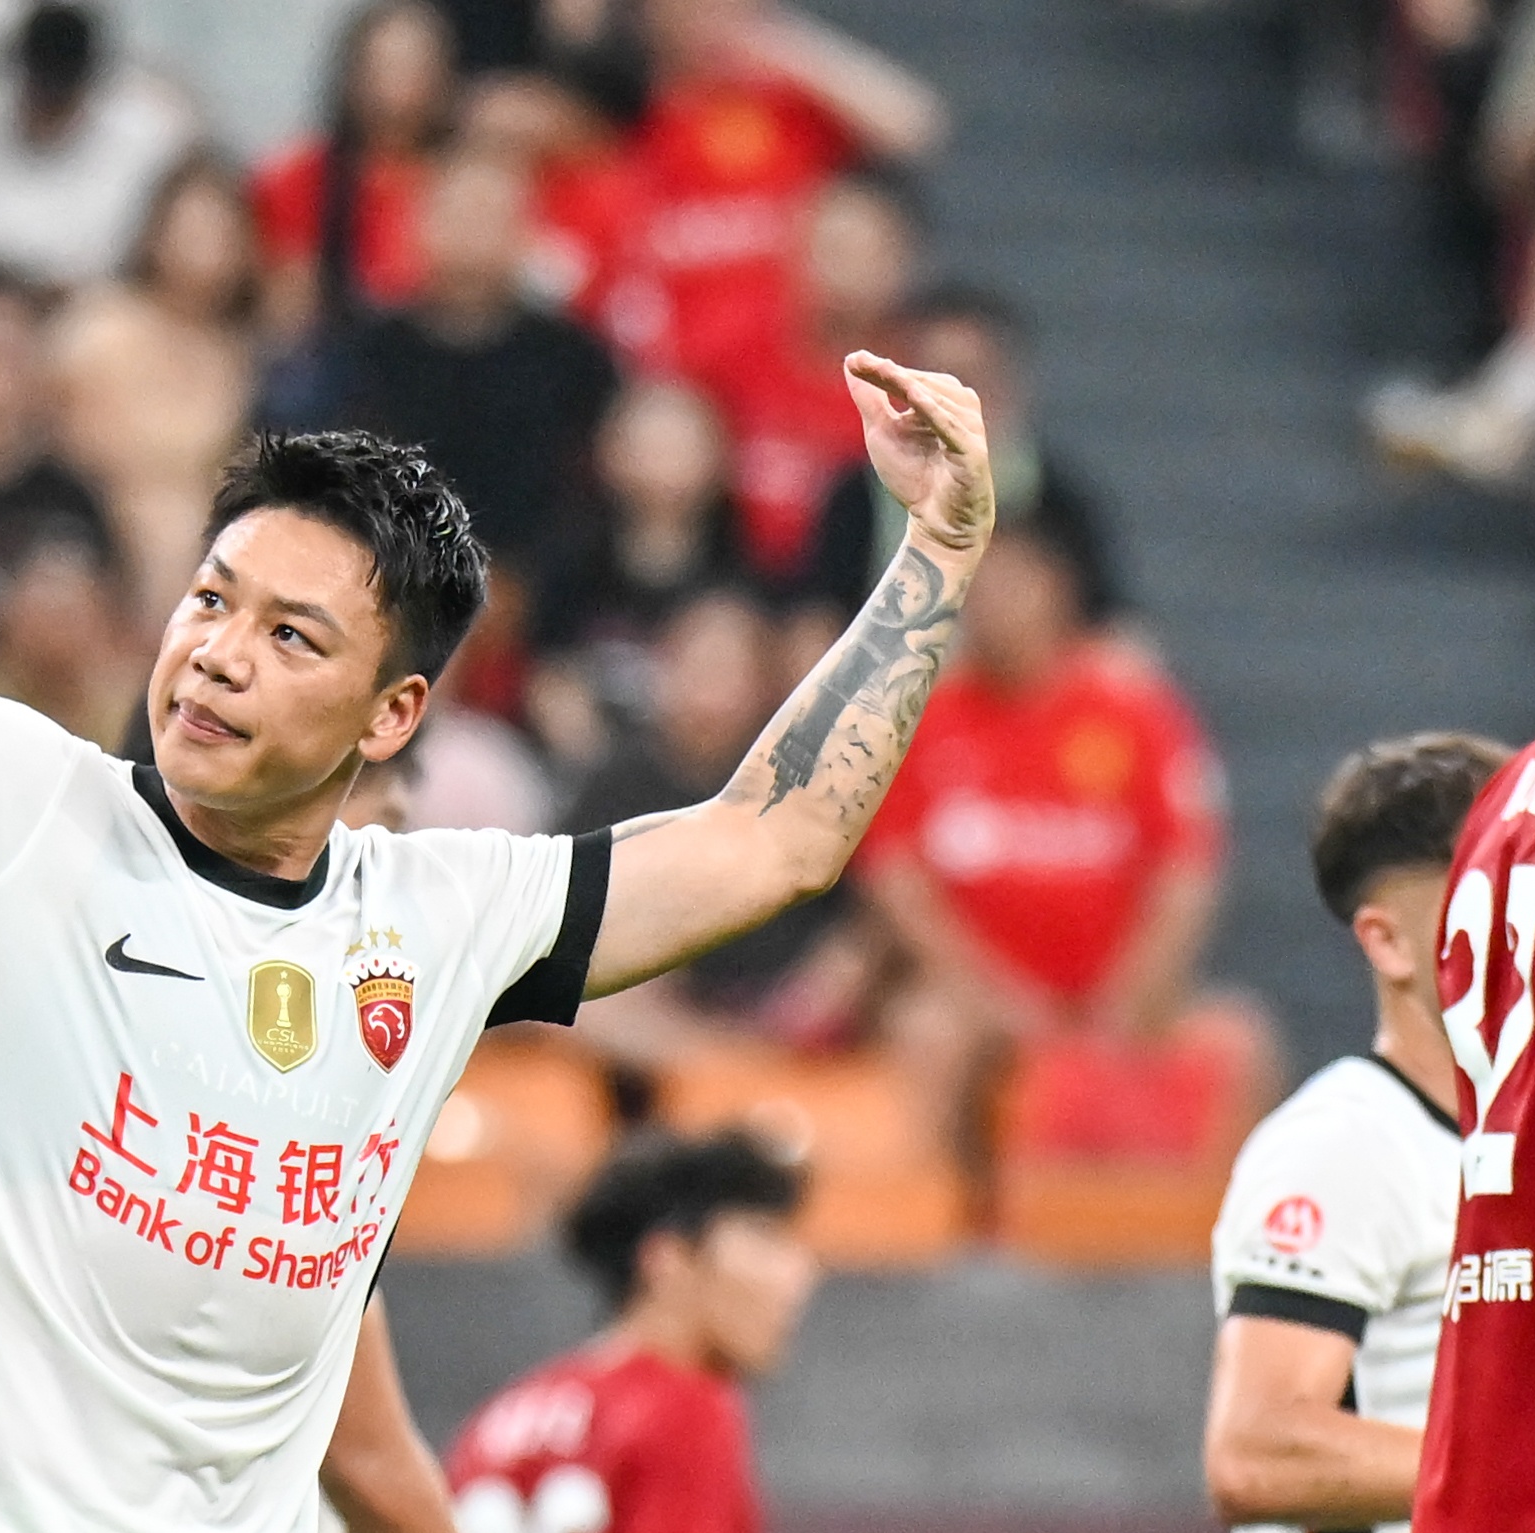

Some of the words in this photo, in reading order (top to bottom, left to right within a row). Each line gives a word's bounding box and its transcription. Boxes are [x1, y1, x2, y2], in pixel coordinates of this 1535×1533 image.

[266, 1027, 300, 1045] CSL
[68, 1147, 183, 1252] Bank
[185, 1226, 234, 1271] of
[242, 1205, 383, 1291] Shanga
